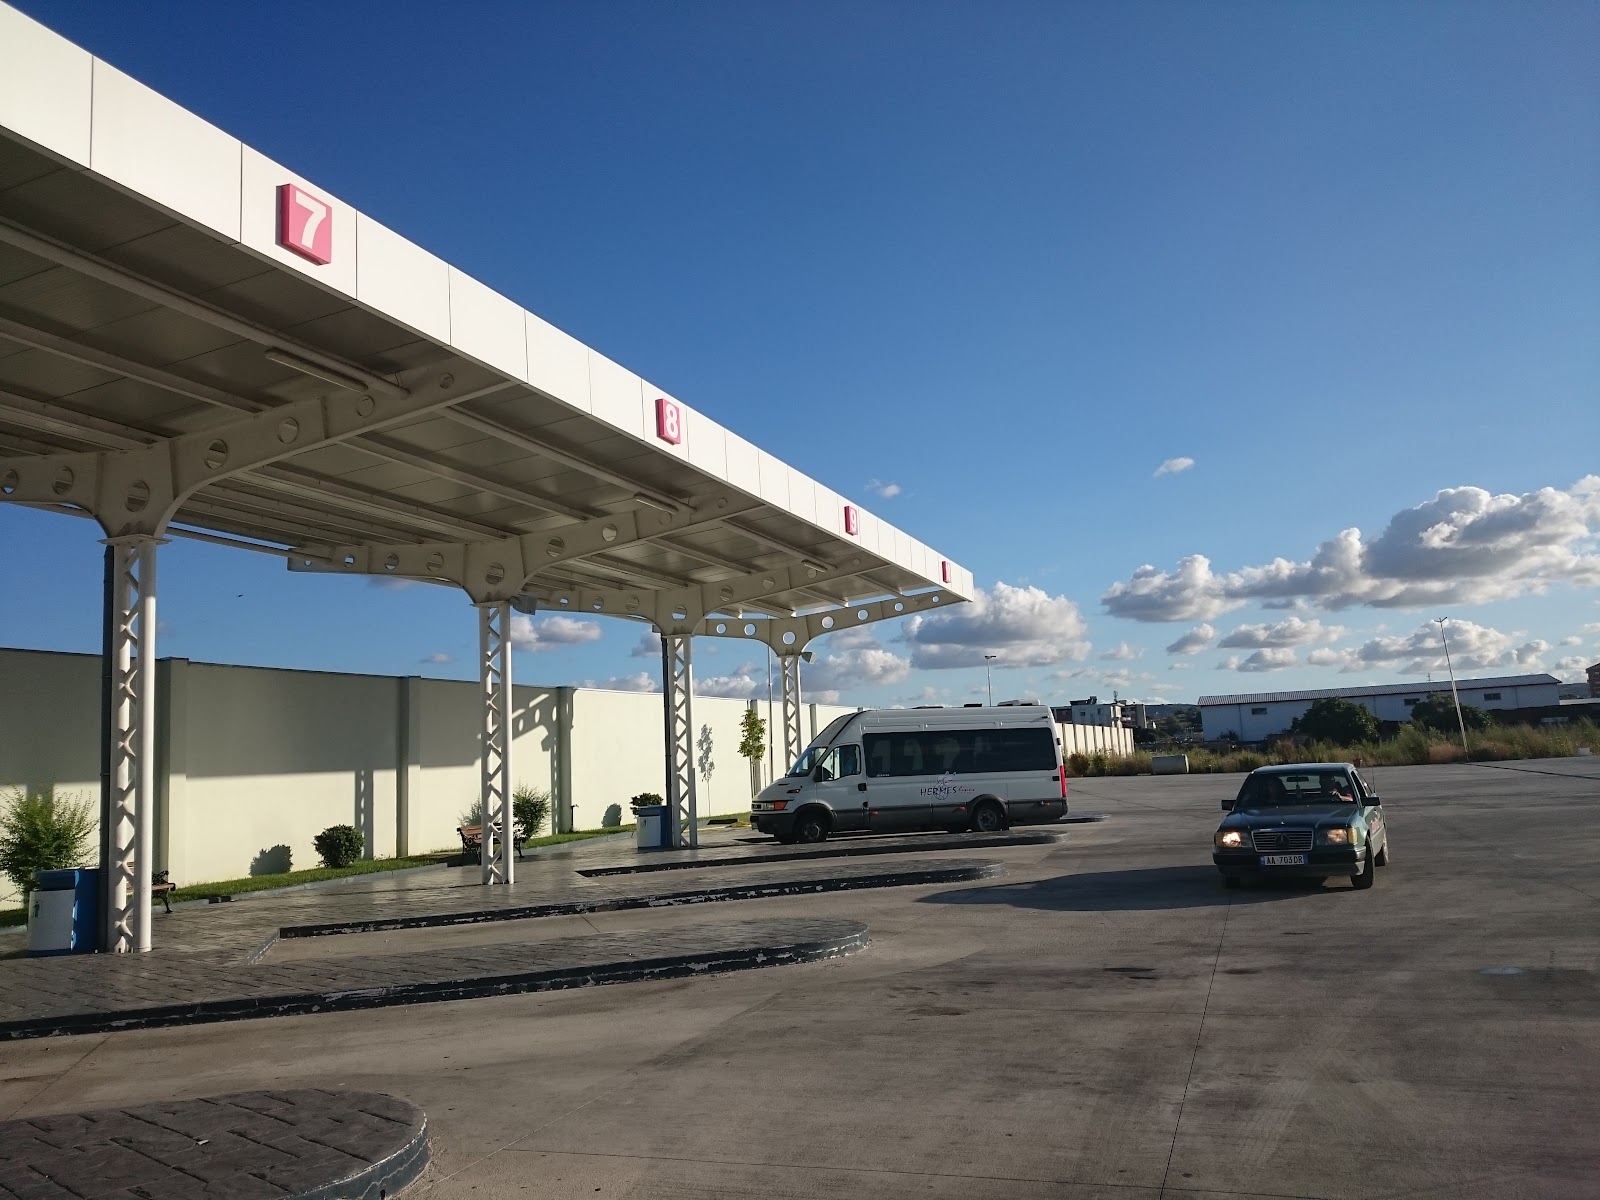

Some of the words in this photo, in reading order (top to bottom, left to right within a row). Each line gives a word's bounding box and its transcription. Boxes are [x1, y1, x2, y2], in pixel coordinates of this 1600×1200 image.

[295, 189, 327, 250] 7
[665, 403, 679, 439] 8
[920, 786, 957, 796] HERMES
